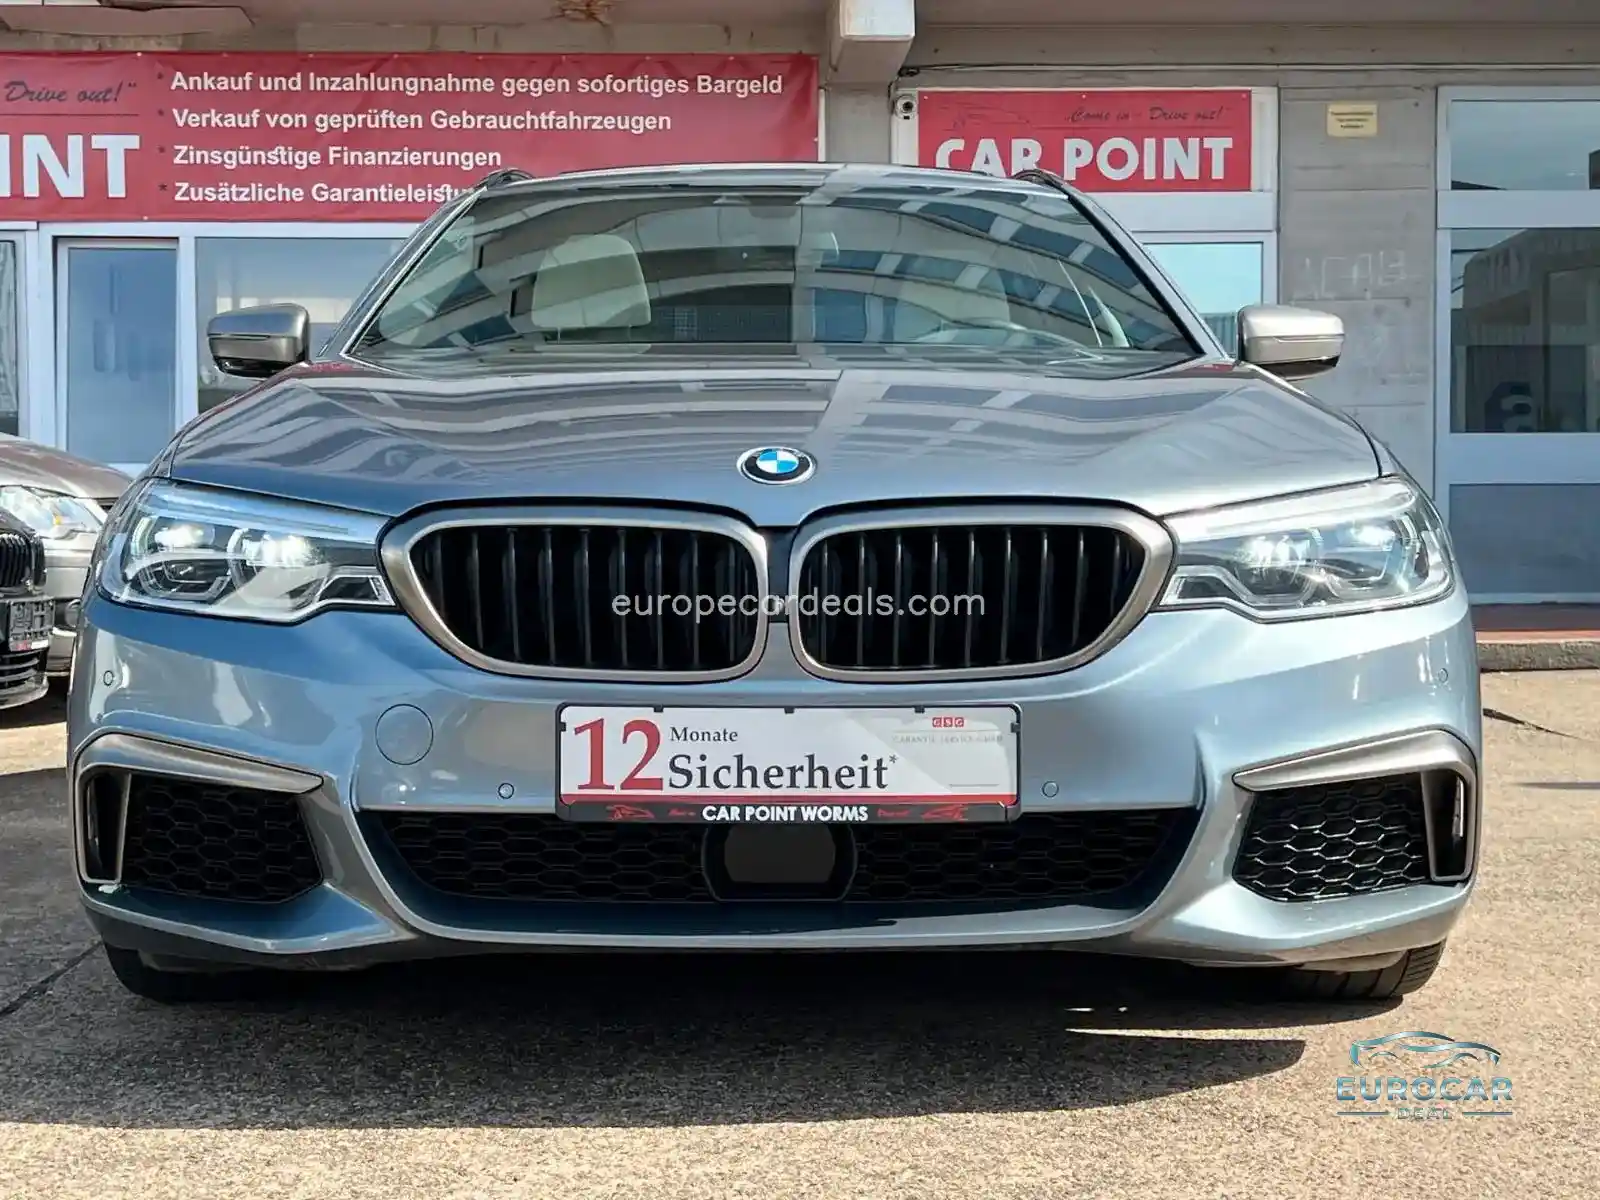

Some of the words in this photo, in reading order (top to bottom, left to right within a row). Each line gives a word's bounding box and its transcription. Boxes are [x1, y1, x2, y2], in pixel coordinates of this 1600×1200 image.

[5, 80, 67, 103] Drive
[170, 71, 253, 91] Ankauf
[259, 71, 302, 91] und
[309, 71, 494, 97] Inzahlungnahme
[501, 78, 570, 98] gegen
[577, 74, 690, 98] sofortiges
[697, 74, 783, 99] Bargeld
[172, 108, 261, 128] Verkauf
[265, 113, 308, 128] von
[314, 109, 423, 133] geprüften
[430, 109, 672, 135] Gebrauchtfahrzeugen
[173, 144, 321, 170] Zinsgünstige
[328, 146, 502, 171] Finanzierungen
[1063, 137, 1233, 182] POINT
[174, 182, 305, 202] Zusätzliche
[311, 182, 474, 203] Garantieleist
[670, 726, 738, 742] Monate
[574, 718, 664, 790] 12
[702, 805, 741, 821] CAR
[745, 805, 798, 822] POINT
[800, 805, 869, 822] WORMS
